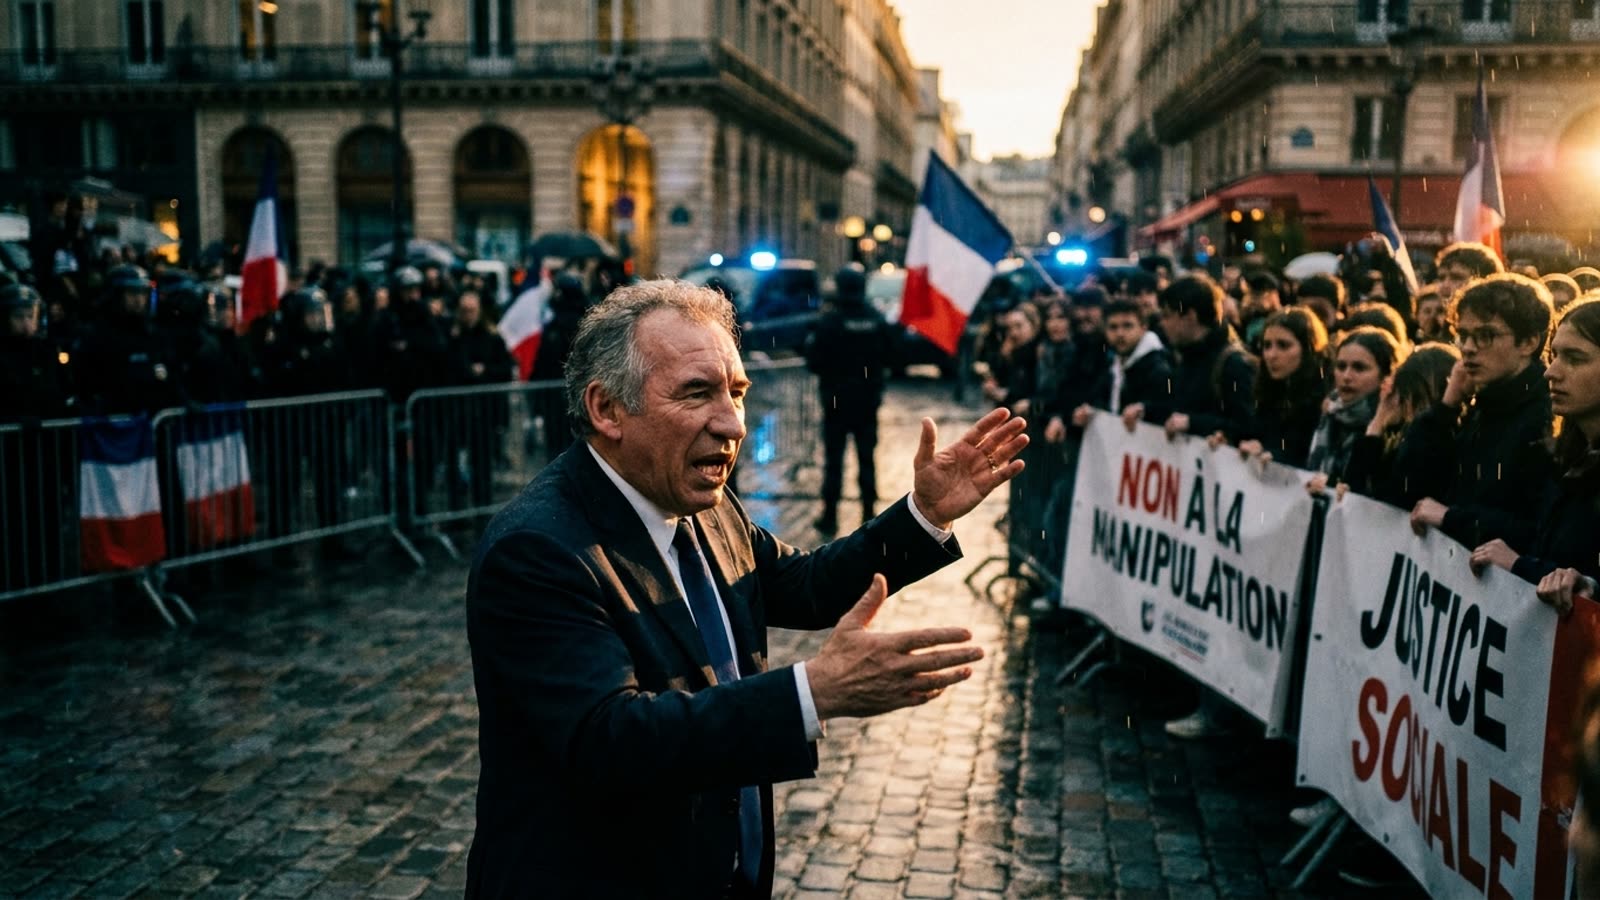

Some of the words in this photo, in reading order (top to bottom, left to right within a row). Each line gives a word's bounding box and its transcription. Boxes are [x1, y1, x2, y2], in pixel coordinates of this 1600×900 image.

[1091, 506, 1288, 651] MANIPULATION
[1116, 453, 1180, 523] NON
[1185, 458, 1207, 535] À
[1213, 482, 1244, 555] LA
[1360, 552, 1508, 752] JUSTICE
[1352, 677, 1522, 900] SOCIALE
